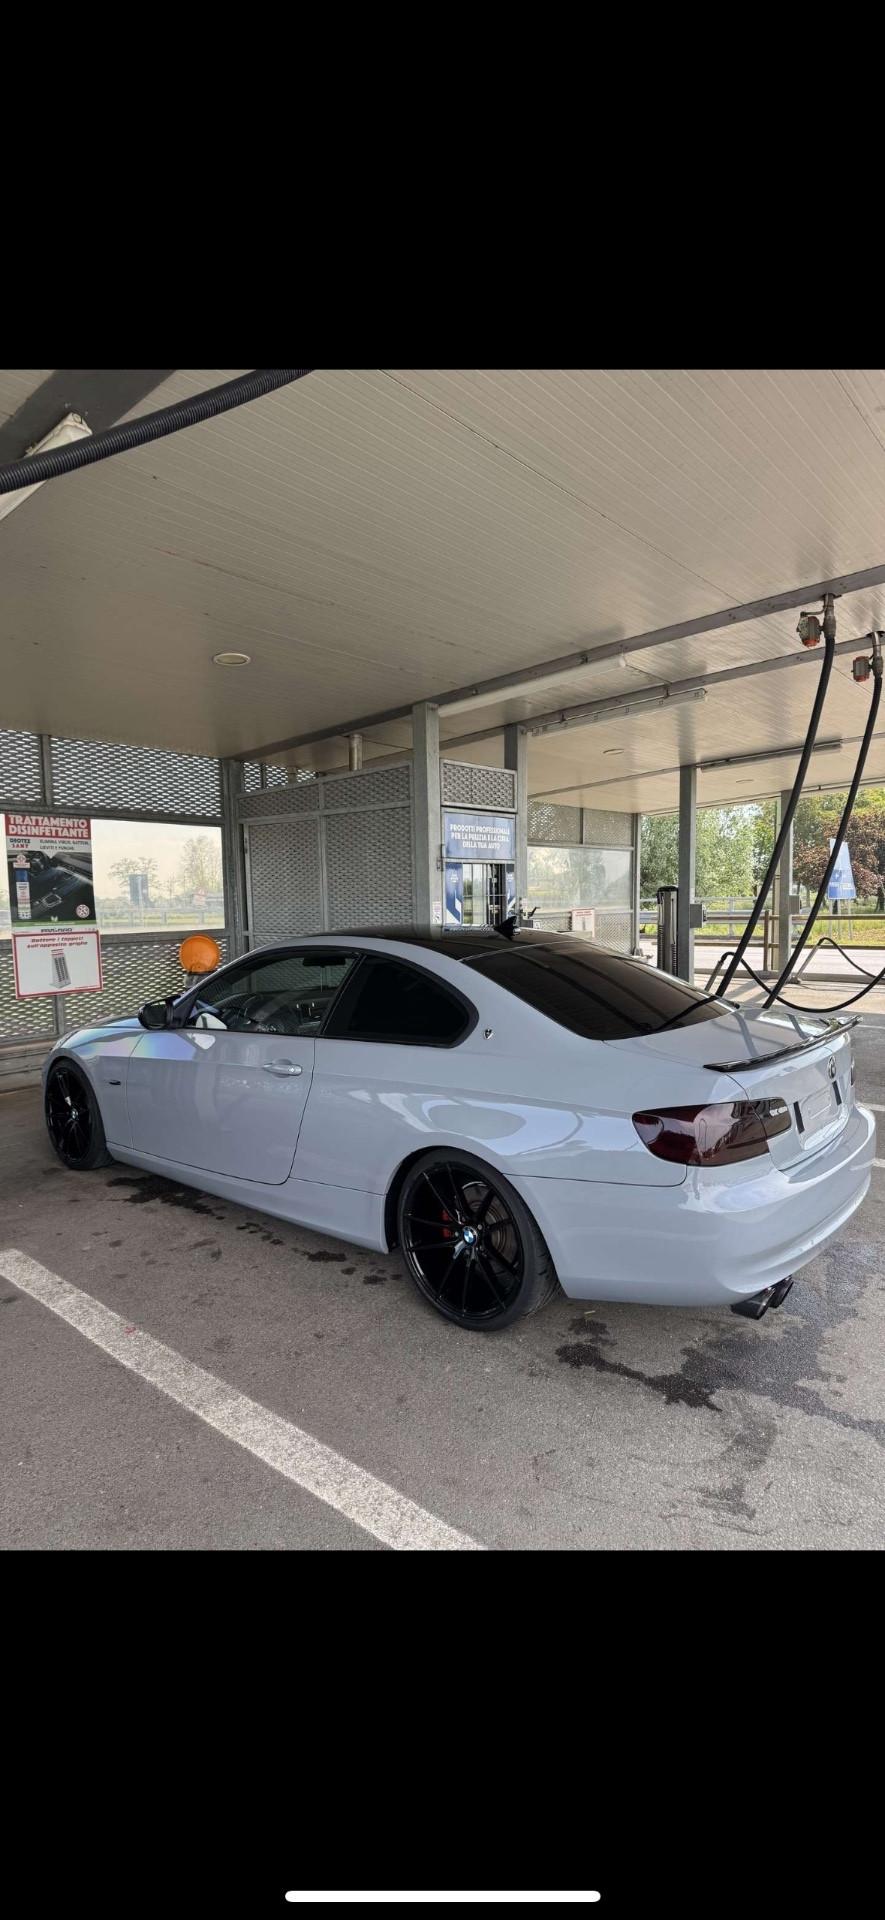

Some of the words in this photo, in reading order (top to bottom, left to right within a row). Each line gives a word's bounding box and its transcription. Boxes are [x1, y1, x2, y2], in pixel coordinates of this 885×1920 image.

[8, 815, 87, 828] TRATTAMENTO
[8, 825, 89, 837] DISINFETTANTE
[450, 824, 475, 833] PRODOTTI
[451, 832, 461, 840] PER
[462, 832, 467, 840] LA
[463, 840, 477, 848] DELLA
[478, 841, 487, 849] TUA
